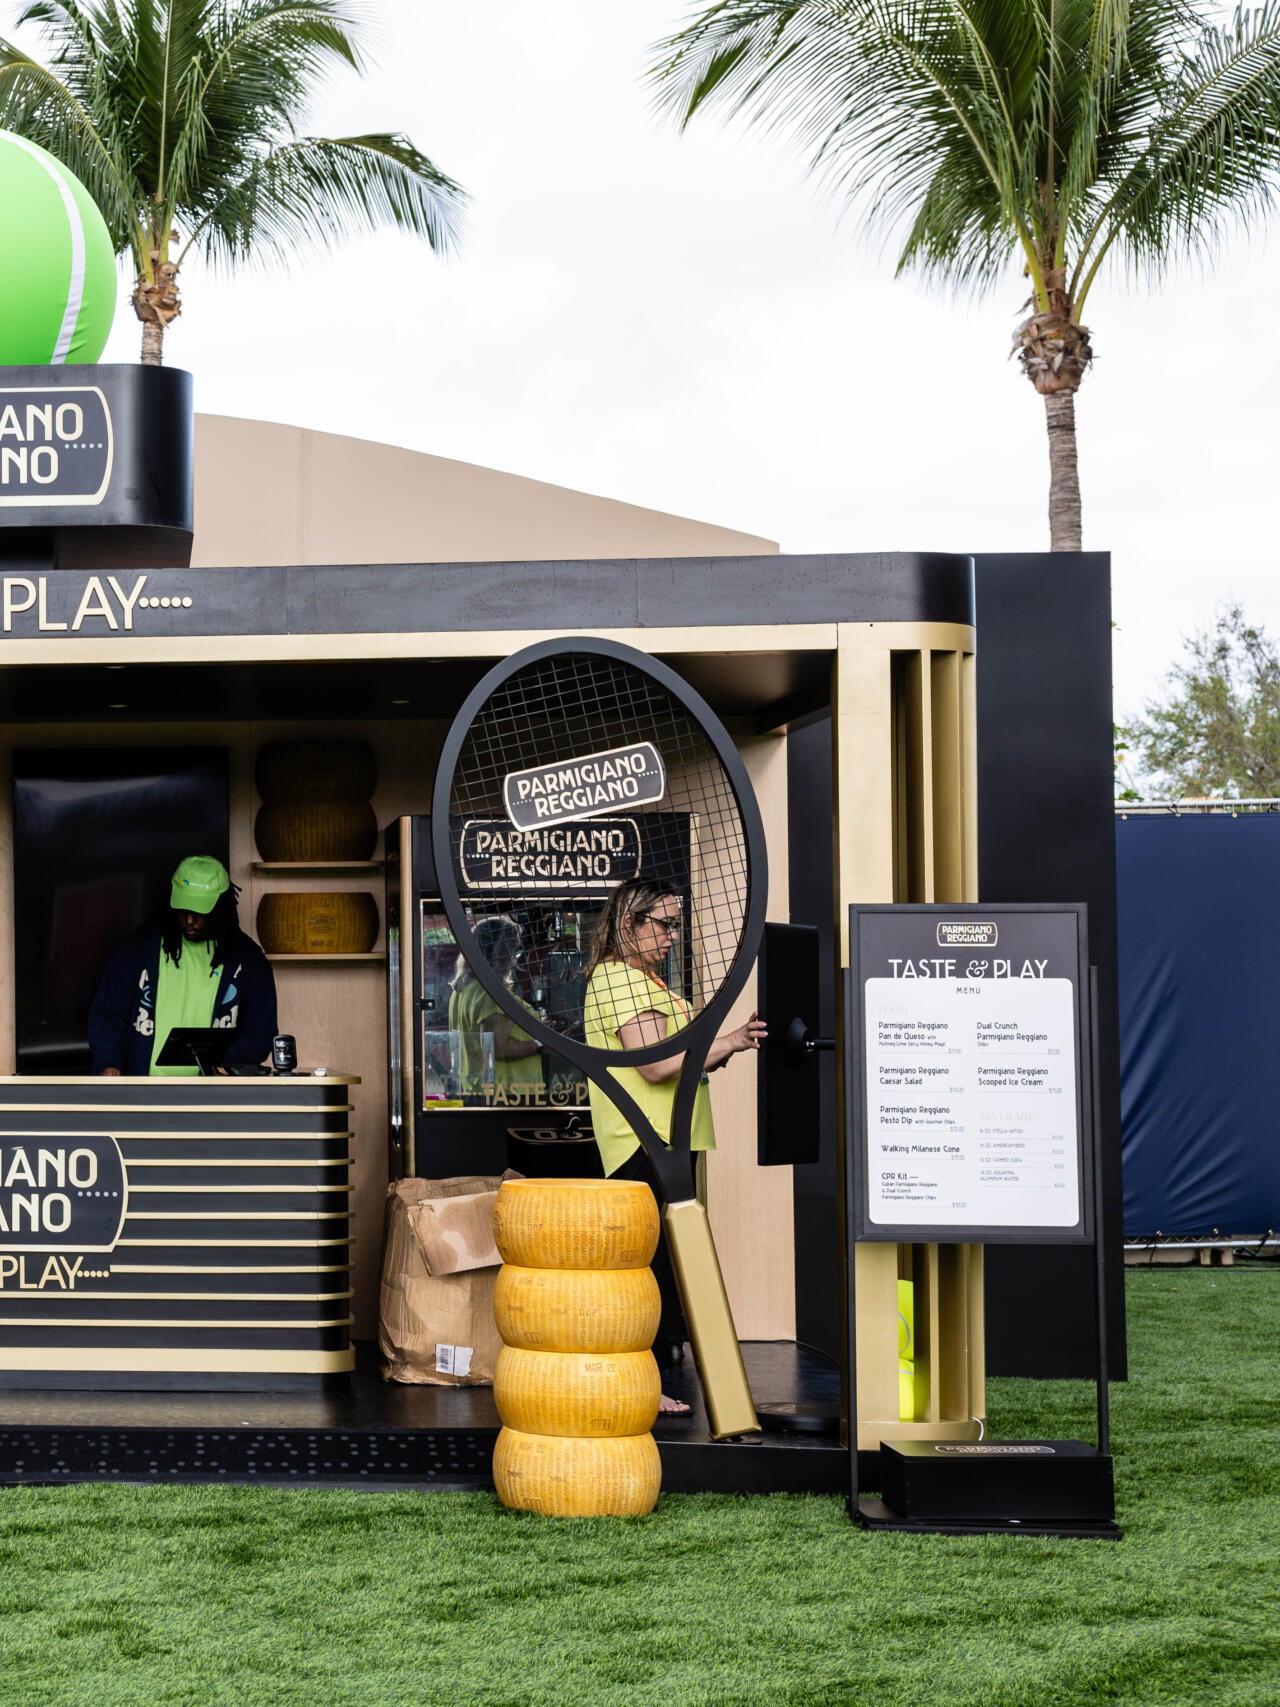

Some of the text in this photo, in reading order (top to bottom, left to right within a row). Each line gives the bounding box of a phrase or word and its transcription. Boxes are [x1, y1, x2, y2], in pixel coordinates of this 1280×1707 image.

[3, 575, 148, 632] PLAY
[516, 752, 647, 800] PARMIGIANO
[534, 777, 639, 818] REGGIANO
[476, 830, 625, 854] PARMIGIANO
[491, 853, 611, 877] REGGIANO
[942, 925, 992, 934] PARMIGIANO
[947, 934, 987, 942] REGGIANO
[888, 959, 1048, 978] TASTE & PLAY
[878, 1022, 948, 1031] Parmigiano Reggiano
[977, 1033, 1048, 1042] Parmigiano Reggiano
[880, 1066, 949, 1076] Parmigiano Reggiano
[978, 1067, 1048, 1076] Parmigiano Reggiano
[978, 1078, 1006, 1086] Scooped
[481, 1083, 547, 1106] TASTE
[549, 1082, 573, 1106] &
[880, 1106, 950, 1114] Parmigiano Reggiano
[902, 1116, 912, 1126] Dip
[881, 1145, 909, 1154] Walking
